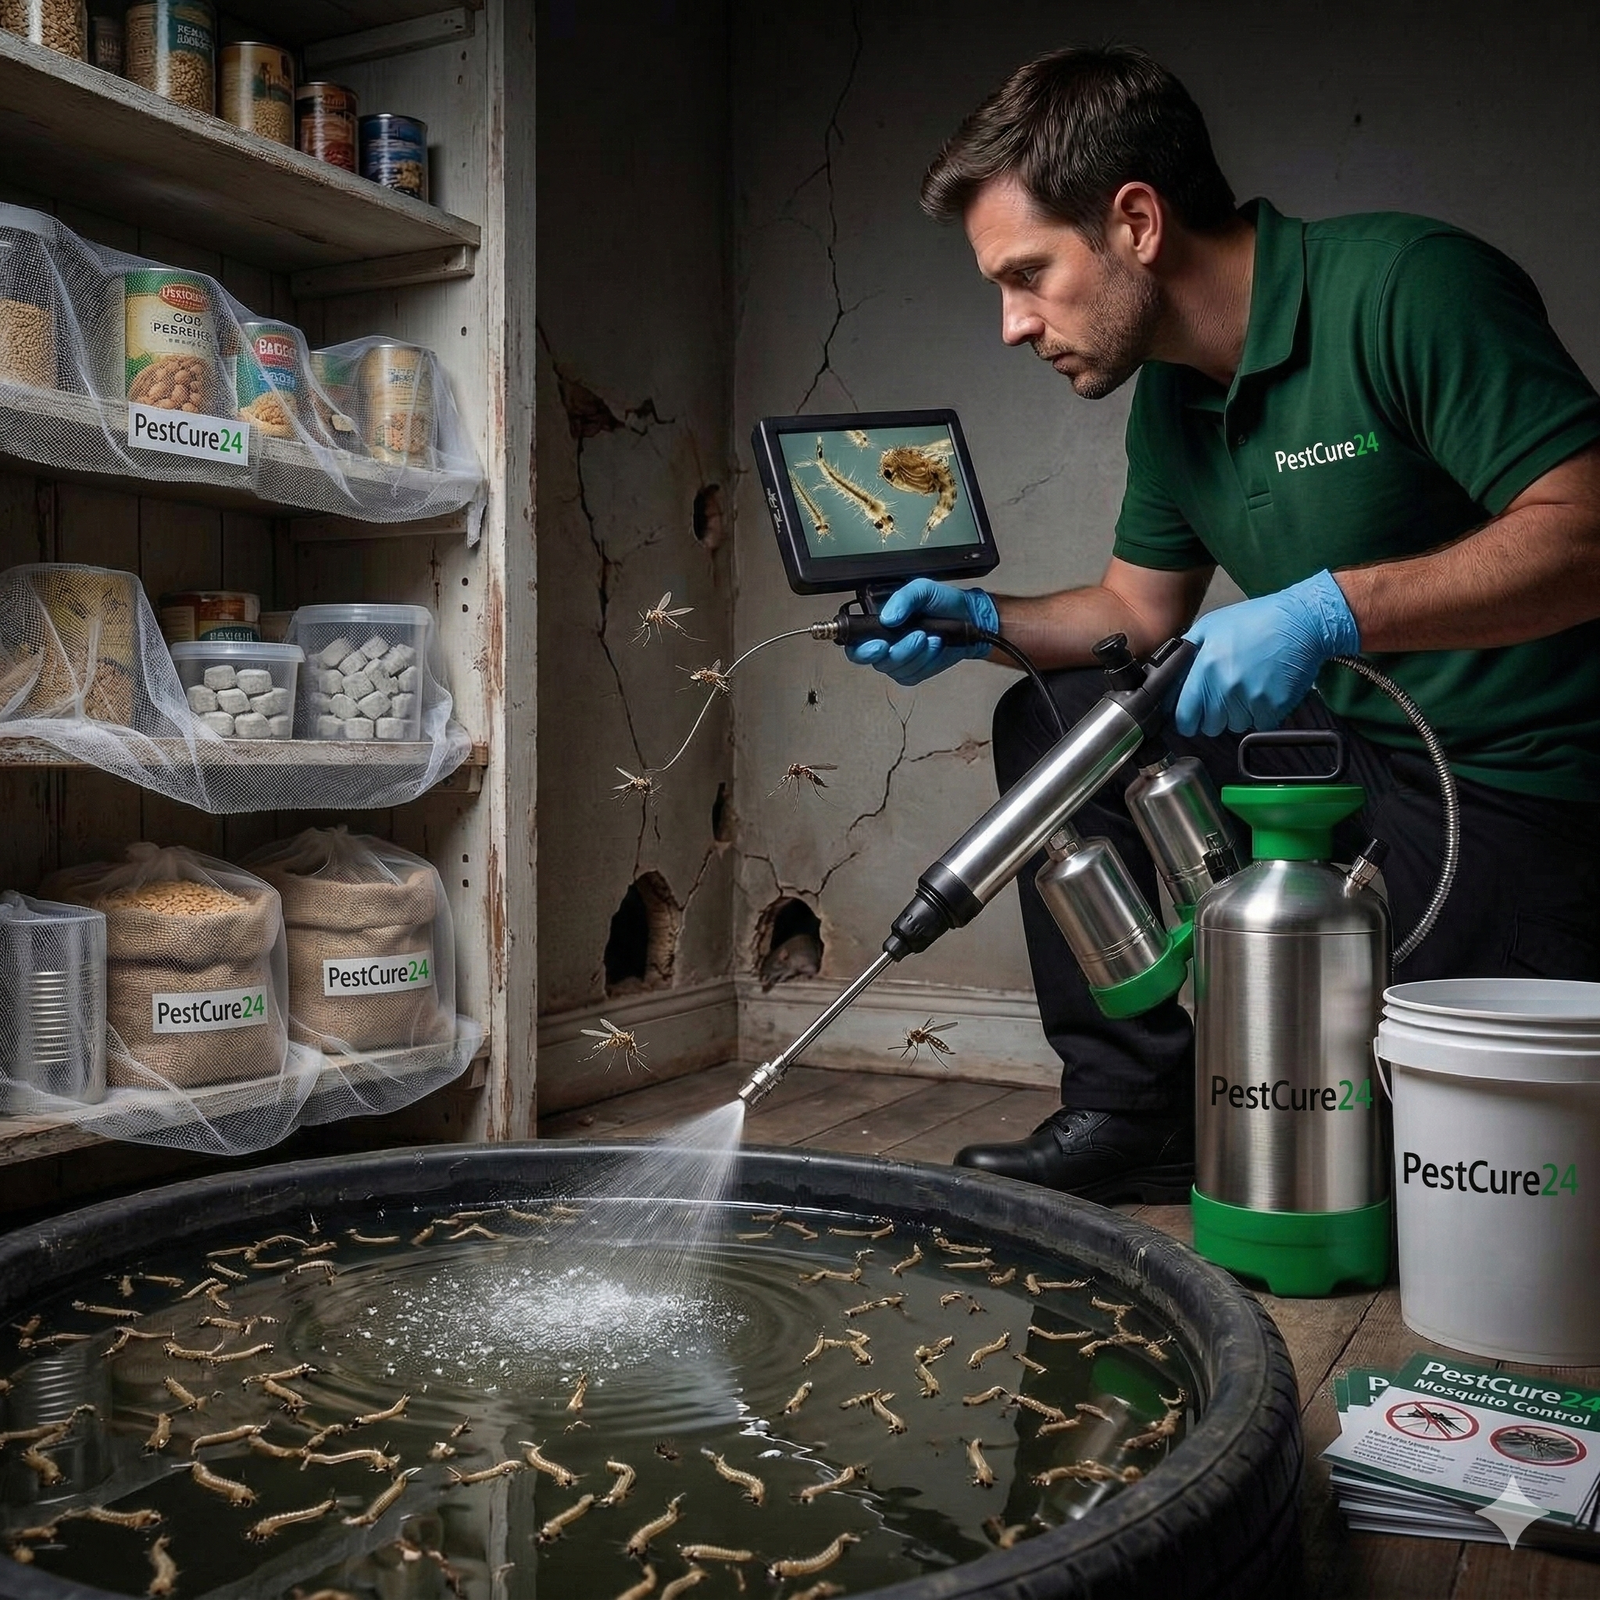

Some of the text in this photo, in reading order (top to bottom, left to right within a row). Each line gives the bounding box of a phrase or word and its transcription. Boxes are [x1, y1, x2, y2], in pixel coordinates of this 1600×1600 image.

[135, 412, 243, 454] PestCure24
[1274, 431, 1379, 473] PestCure24
[328, 958, 430, 988] PestCure24
[157, 993, 265, 1025] PestCure24
[1210, 1075, 1374, 1112] PestCure24
[1402, 1151, 1580, 1197] PestCure24
[1413, 1378, 1592, 1426] Mosquito Control
[1421, 1361, 1600, 1413] PestCure24
